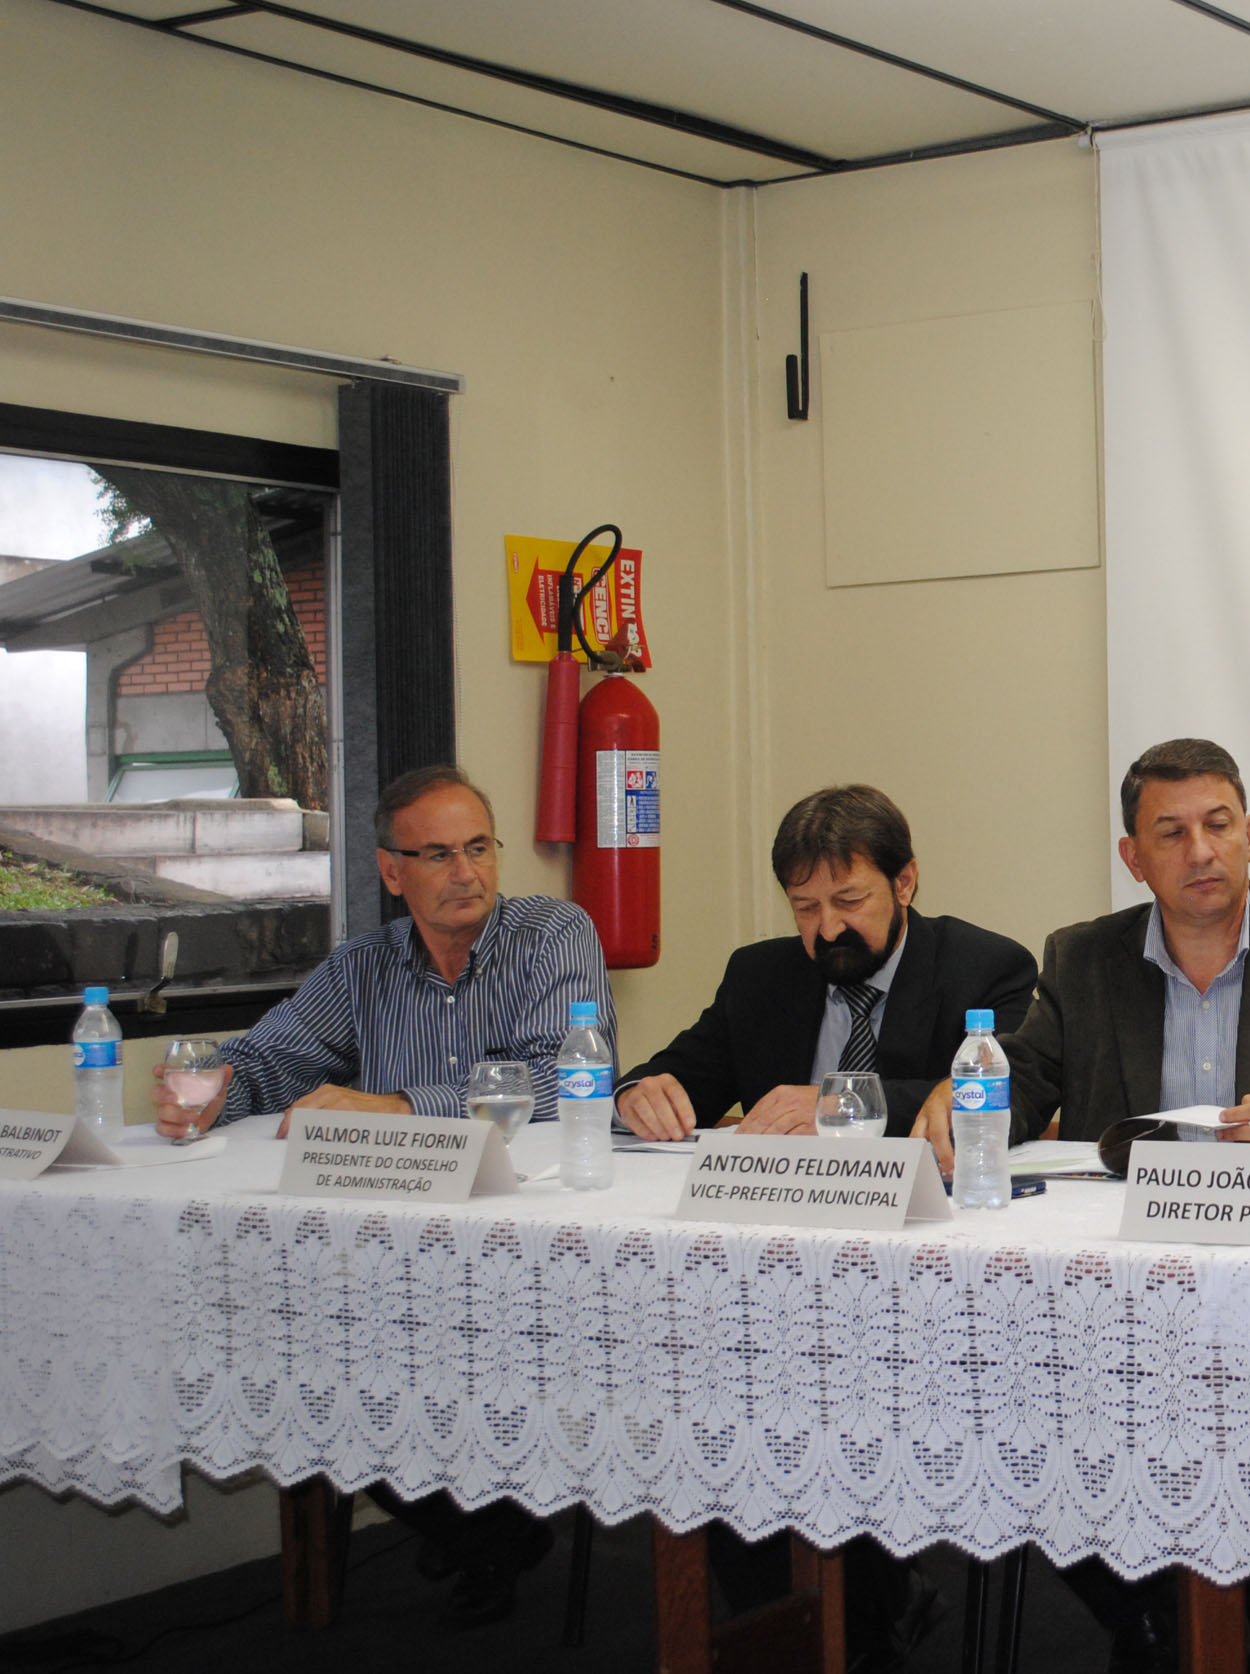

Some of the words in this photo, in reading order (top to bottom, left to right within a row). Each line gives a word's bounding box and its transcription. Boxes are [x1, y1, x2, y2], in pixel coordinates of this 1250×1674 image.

[537, 575, 548, 627] ELETRICIDADE
[563, 1078, 594, 1089] crystal
[954, 1089, 985, 1100] crystal
[0, 1124, 63, 1143] BALBINOT
[304, 1125, 371, 1145] VALMOR
[374, 1130, 409, 1147] LUIZ
[410, 1132, 468, 1150] FIORINI
[0, 1147, 42, 1160] TRATIVO
[302, 1151, 373, 1168] PRESIDENTE
[374, 1156, 394, 1169] DO
[395, 1157, 458, 1173] CONSELHO
[698, 1153, 791, 1176] ANTONIO
[794, 1157, 906, 1180] FELDMANN
[1136, 1166, 1202, 1188] PAULO
[316, 1173, 333, 1187] DE
[334, 1175, 432, 1194] ADMINISTRAÇÃO
[690, 1183, 805, 1204] VICE-PREFEITO
[807, 1188, 899, 1208] MUNICIPAL
[1146, 1200, 1234, 1222] DIRETOR
